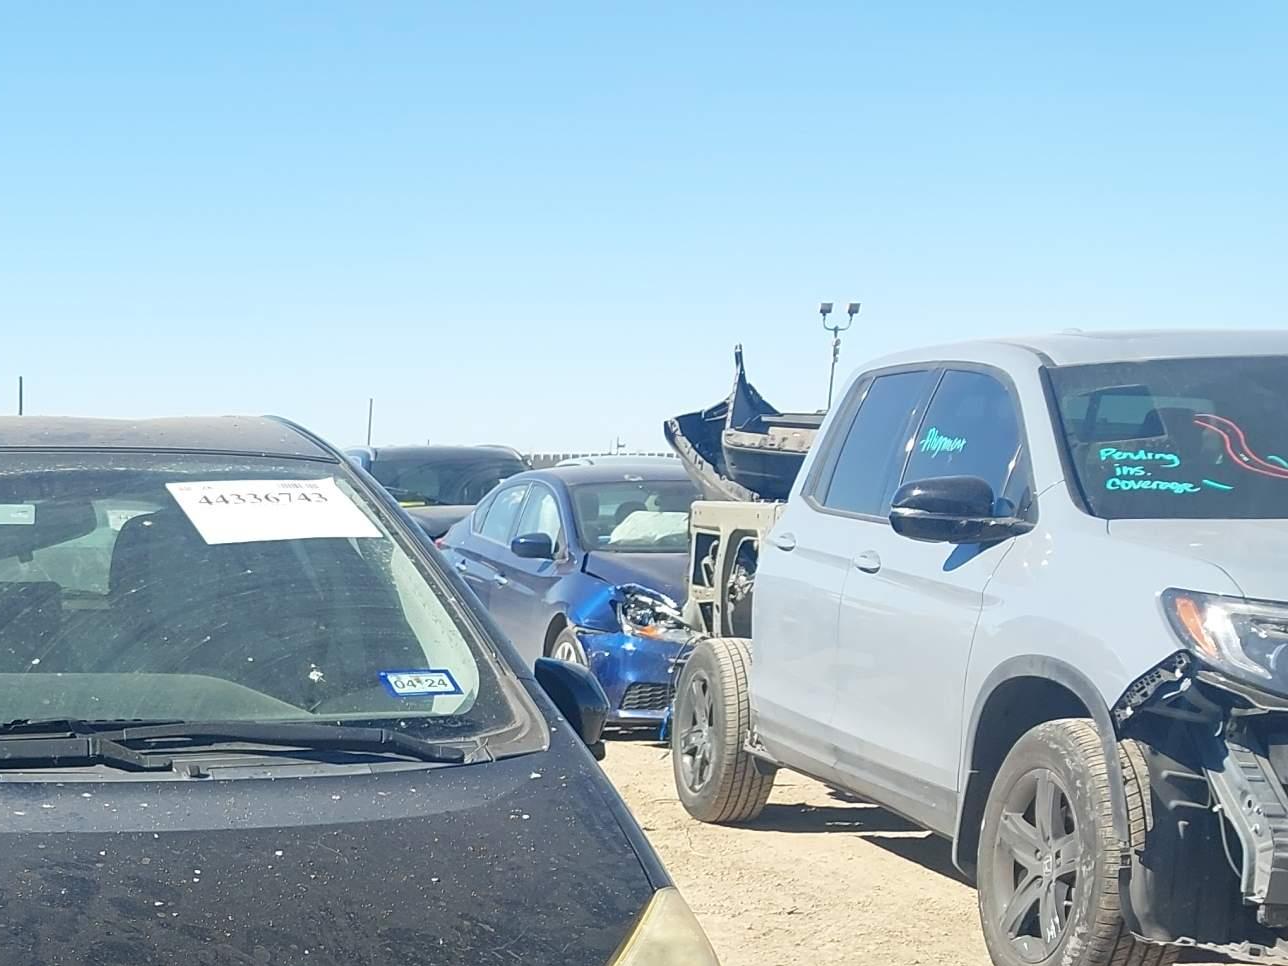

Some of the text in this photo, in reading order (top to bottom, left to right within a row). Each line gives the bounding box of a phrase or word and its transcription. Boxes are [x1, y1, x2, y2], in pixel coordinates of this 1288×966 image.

[1099, 447, 1181, 468] Pending
[1105, 477, 1201, 494] Coverage
[198, 492, 329, 506] 44336743
